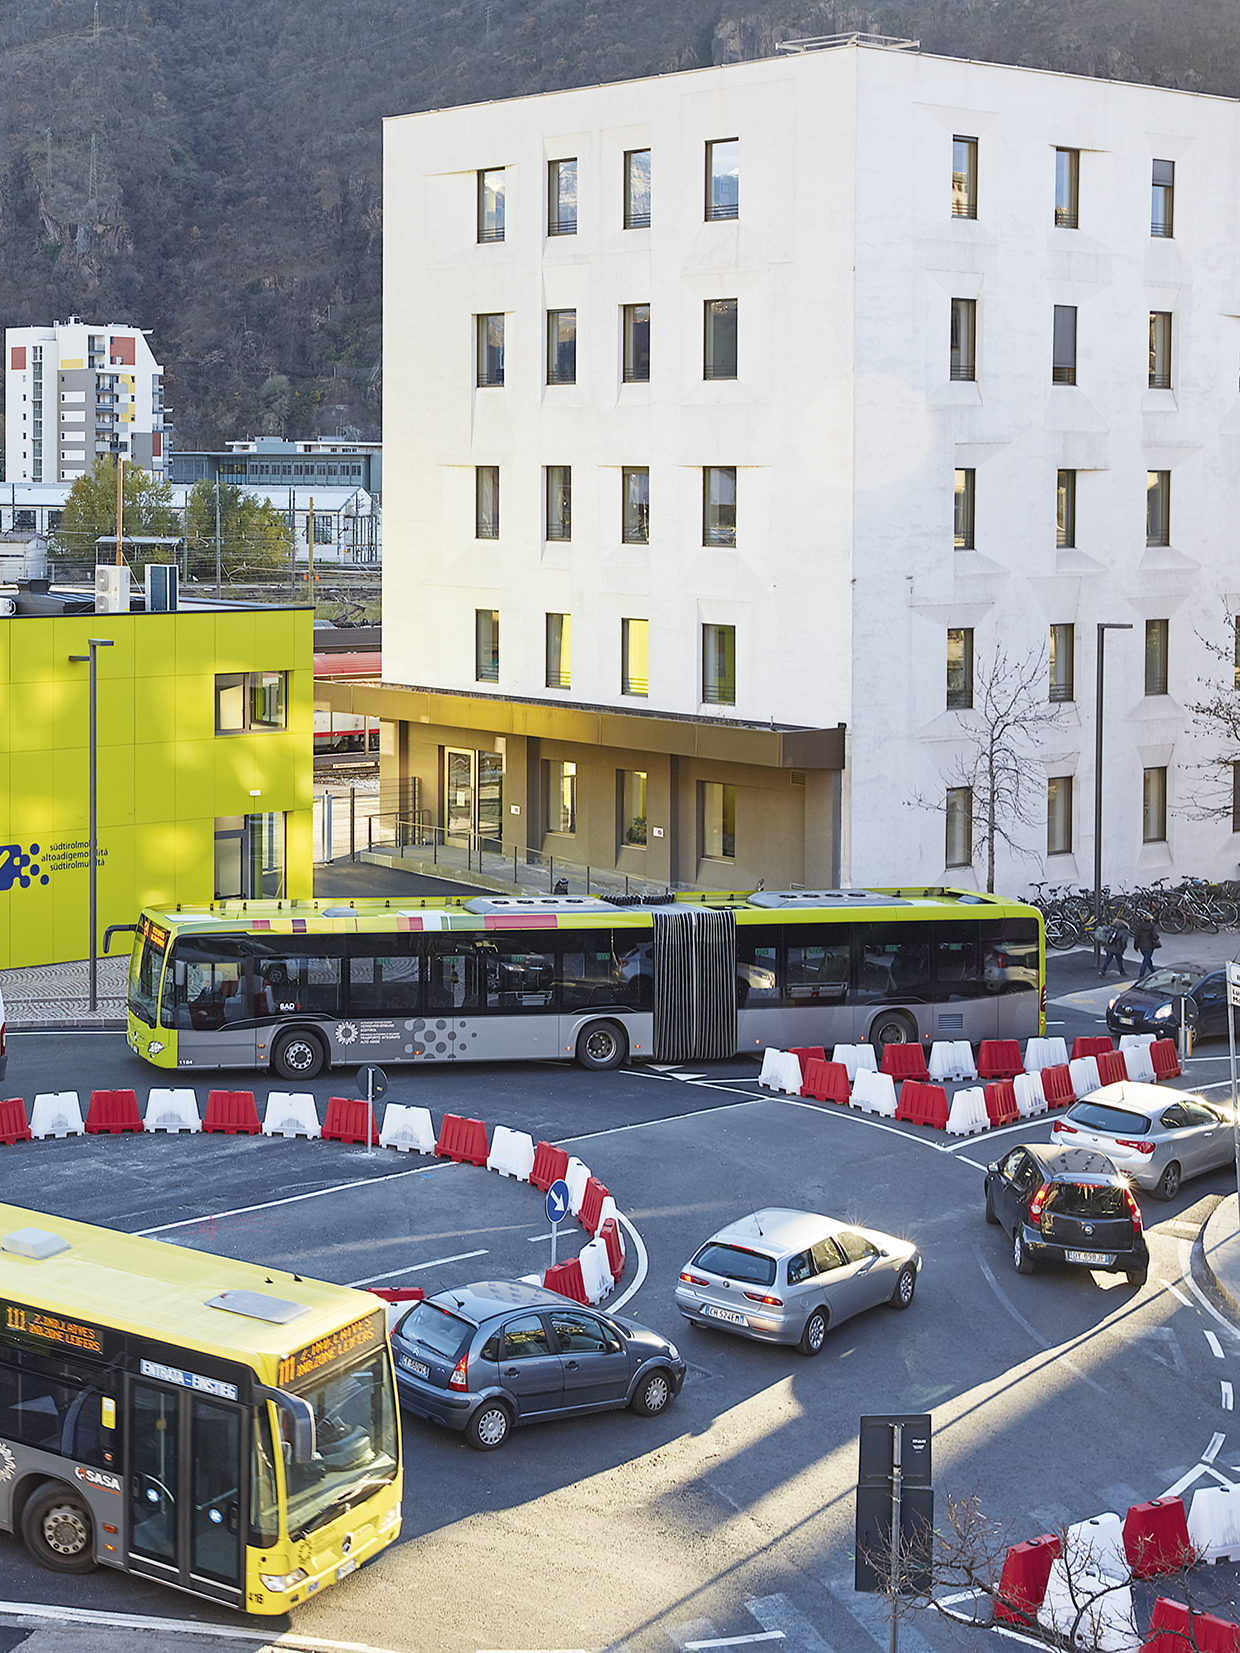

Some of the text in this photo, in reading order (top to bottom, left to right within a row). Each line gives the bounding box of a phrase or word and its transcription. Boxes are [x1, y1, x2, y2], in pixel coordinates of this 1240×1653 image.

[279, 1002, 296, 1010] SAD
[6, 1306, 27, 1331] 111
[279, 1355, 295, 1386] 111
